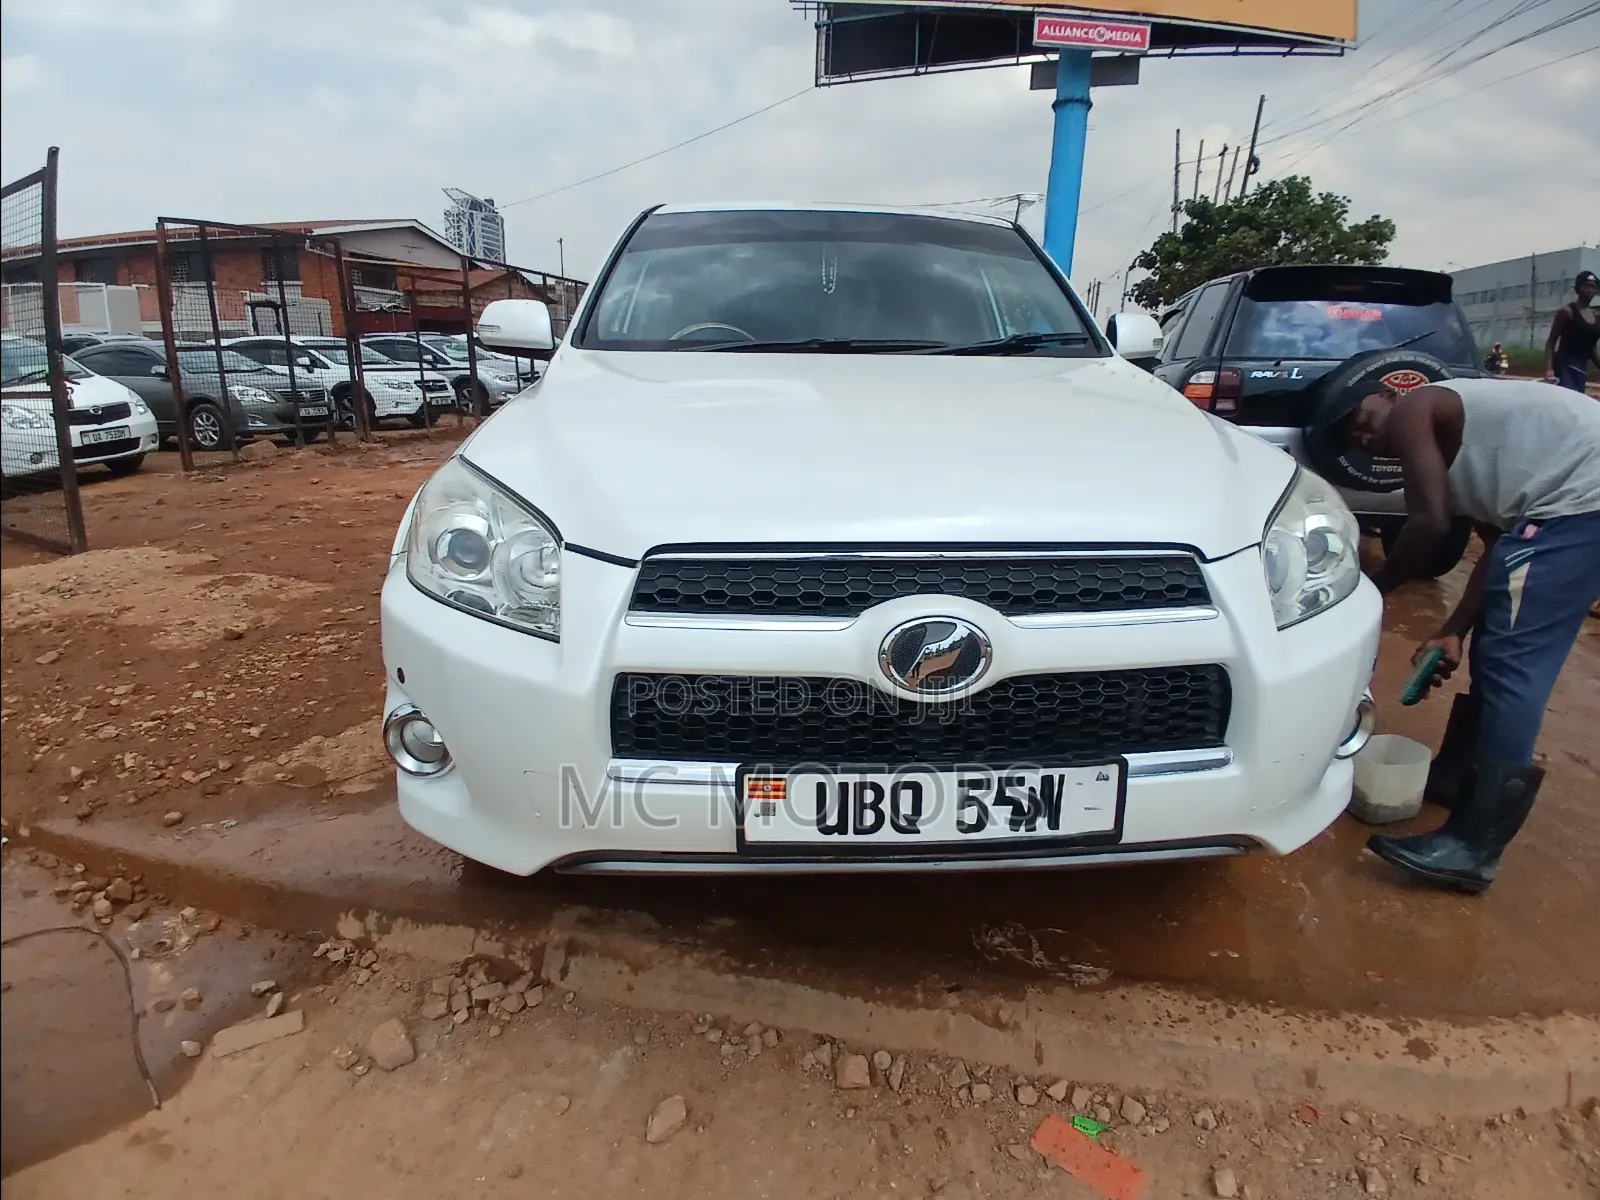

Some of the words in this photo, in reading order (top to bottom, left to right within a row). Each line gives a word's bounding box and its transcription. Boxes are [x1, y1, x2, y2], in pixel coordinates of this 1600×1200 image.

[1041, 24, 1096, 38] ALLIANCE
[1105, 30, 1142, 43] MEDIA
[1371, 464, 1403, 473] TOYOTA
[815, 779, 924, 836] UBQ
